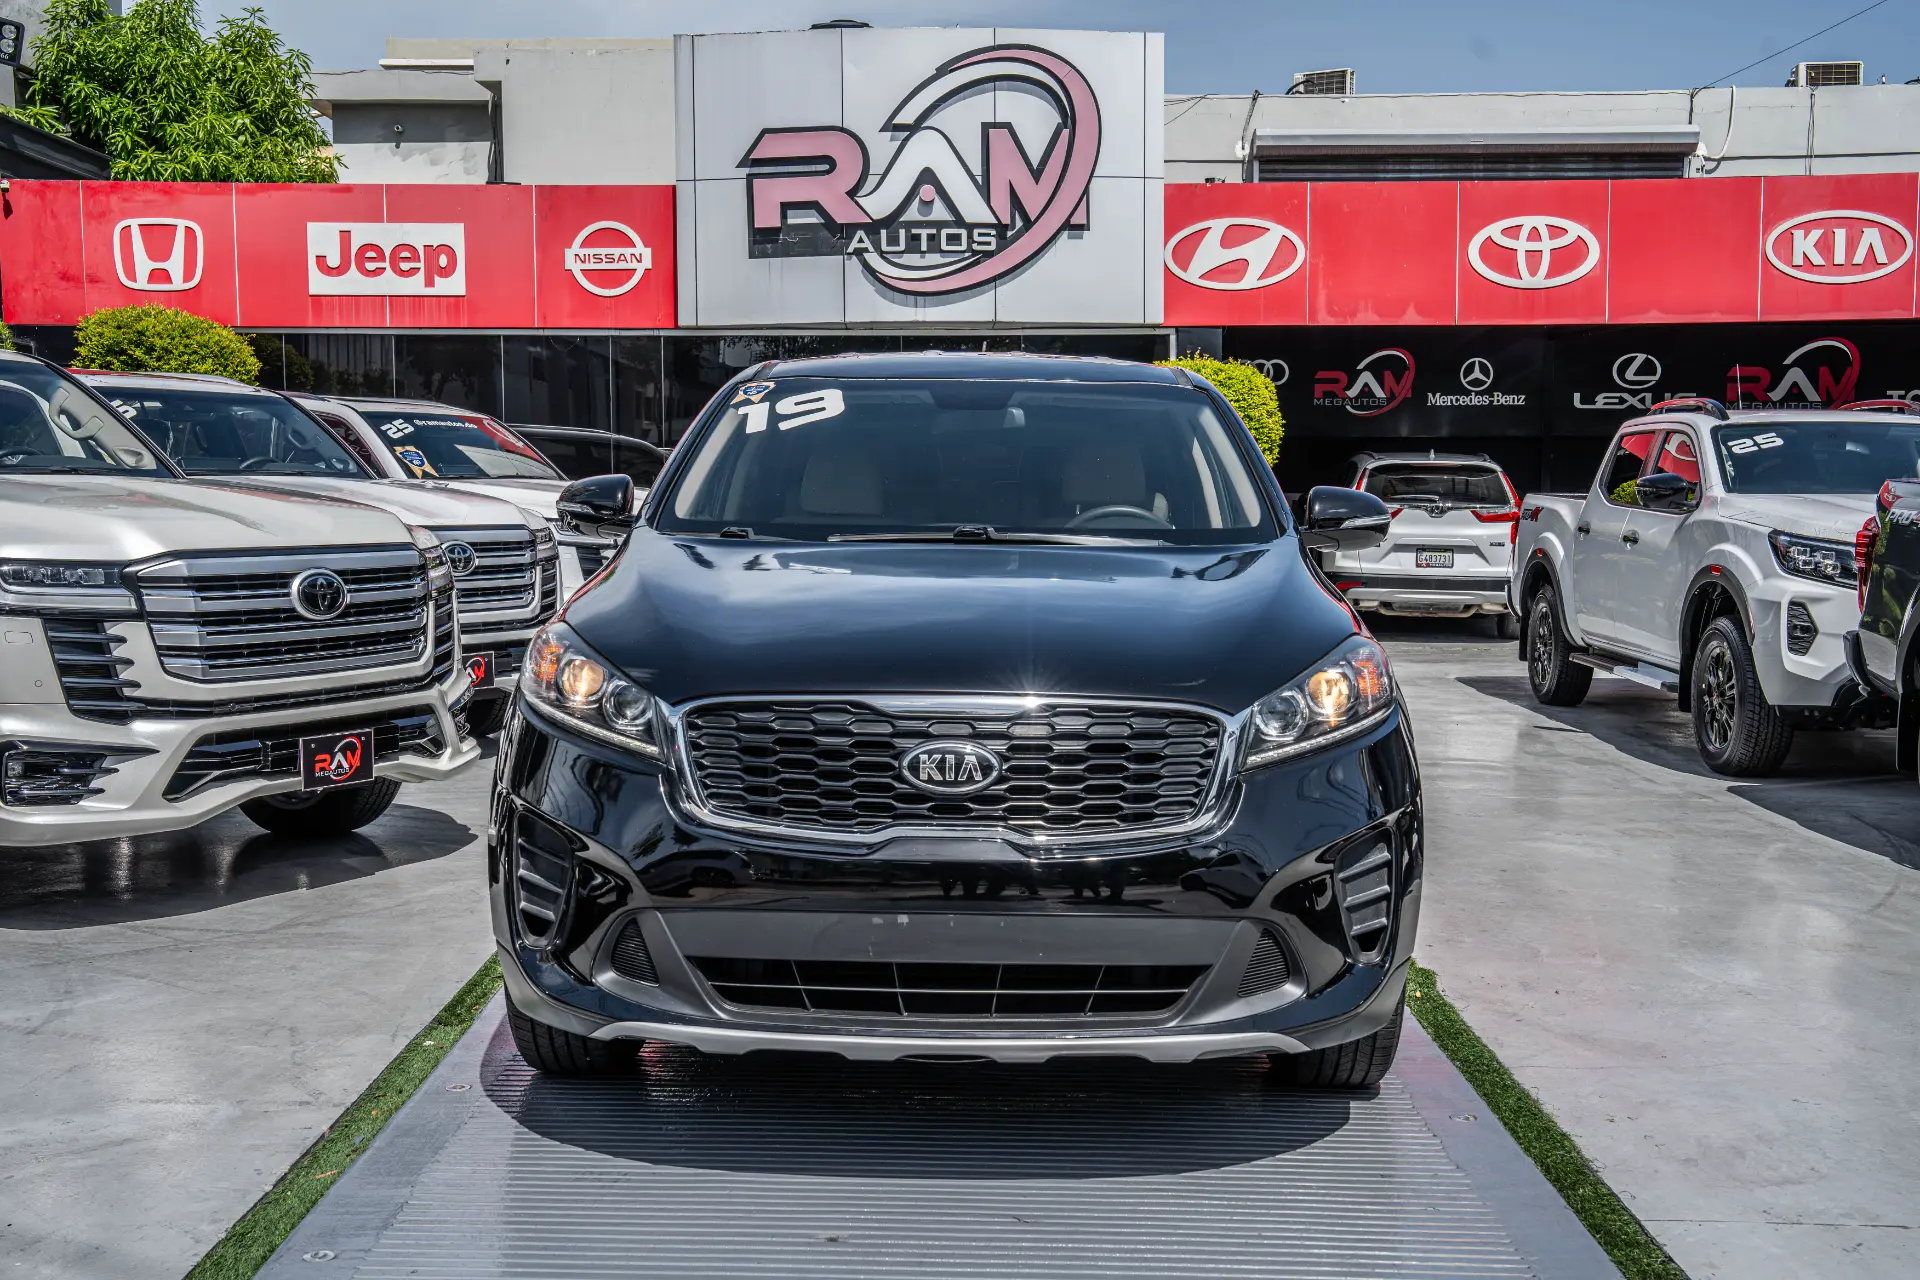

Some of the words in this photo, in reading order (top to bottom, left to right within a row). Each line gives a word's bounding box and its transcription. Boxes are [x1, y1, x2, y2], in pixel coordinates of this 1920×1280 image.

[740, 122, 1091, 231] RAM
[848, 228, 997, 253] AUTOS
[1790, 227, 1889, 267] KIA
[315, 230, 458, 288] Jeep
[574, 253, 643, 264] NISSAN
[1314, 370, 1412, 398] RAM
[1726, 366, 1856, 402] RAM
[738, 388, 845, 434] 19
[1313, 398, 1387, 406] MEGAUTOS
[1426, 391, 1526, 407] Mercedes-Benz
[1725, 401, 1822, 411] MEGAUTOS
[380, 418, 415, 439] 25
[1726, 432, 1785, 454] 25
[314, 750, 361, 773] RAM
[919, 754, 983, 781] KIA
